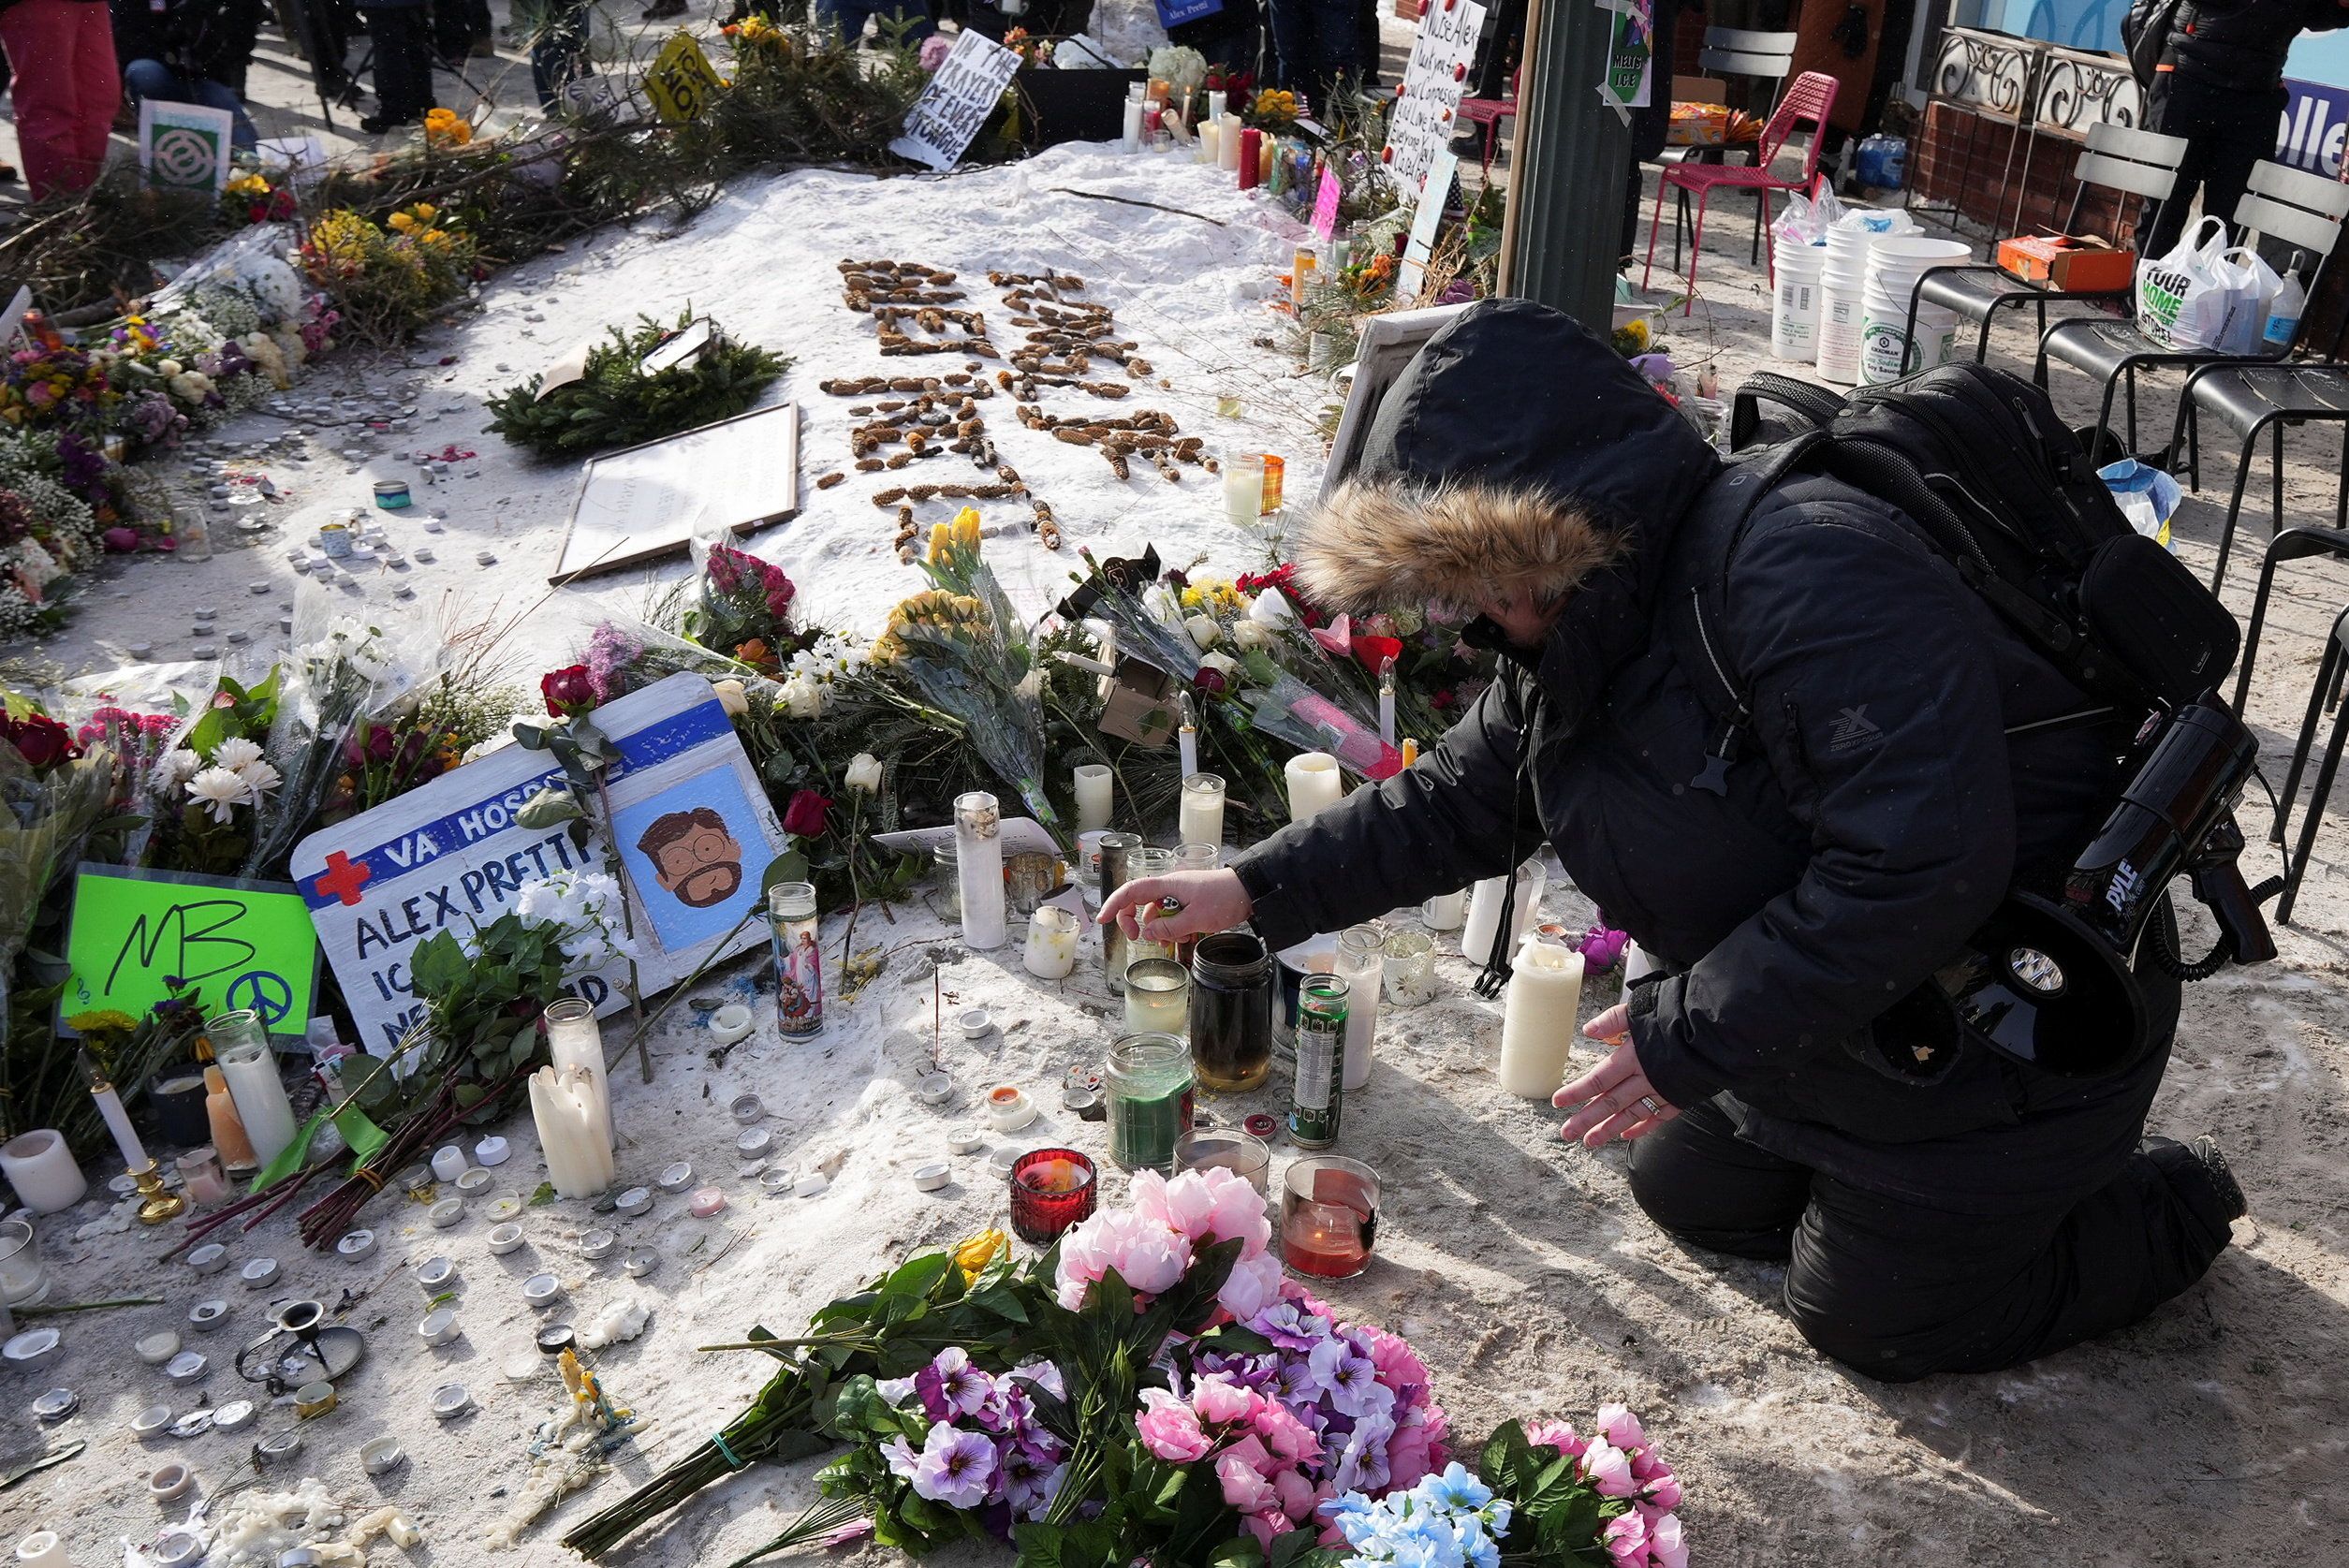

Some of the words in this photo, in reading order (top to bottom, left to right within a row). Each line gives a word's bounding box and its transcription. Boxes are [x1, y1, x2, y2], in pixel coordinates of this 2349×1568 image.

[1168, 7, 1186, 21] Alex
[1186, 1, 1209, 15] Pretti
[953, 33, 980, 59] IN
[981, 44, 1020, 83] THE
[1613, 55, 1642, 69] MELTS
[938, 58, 1002, 112] PRAYERS
[911, 110, 964, 162] TONGUE
[921, 83, 948, 110] OF
[938, 95, 985, 140] EVERY
[2143, 280, 2183, 319] HOME
[2147, 267, 2192, 300] YOUR
[384, 830, 440, 869] VA
[356, 885, 462, 960] ALEX
[459, 831, 592, 915] PRETTI
[2106, 860, 2138, 912] PYLE
